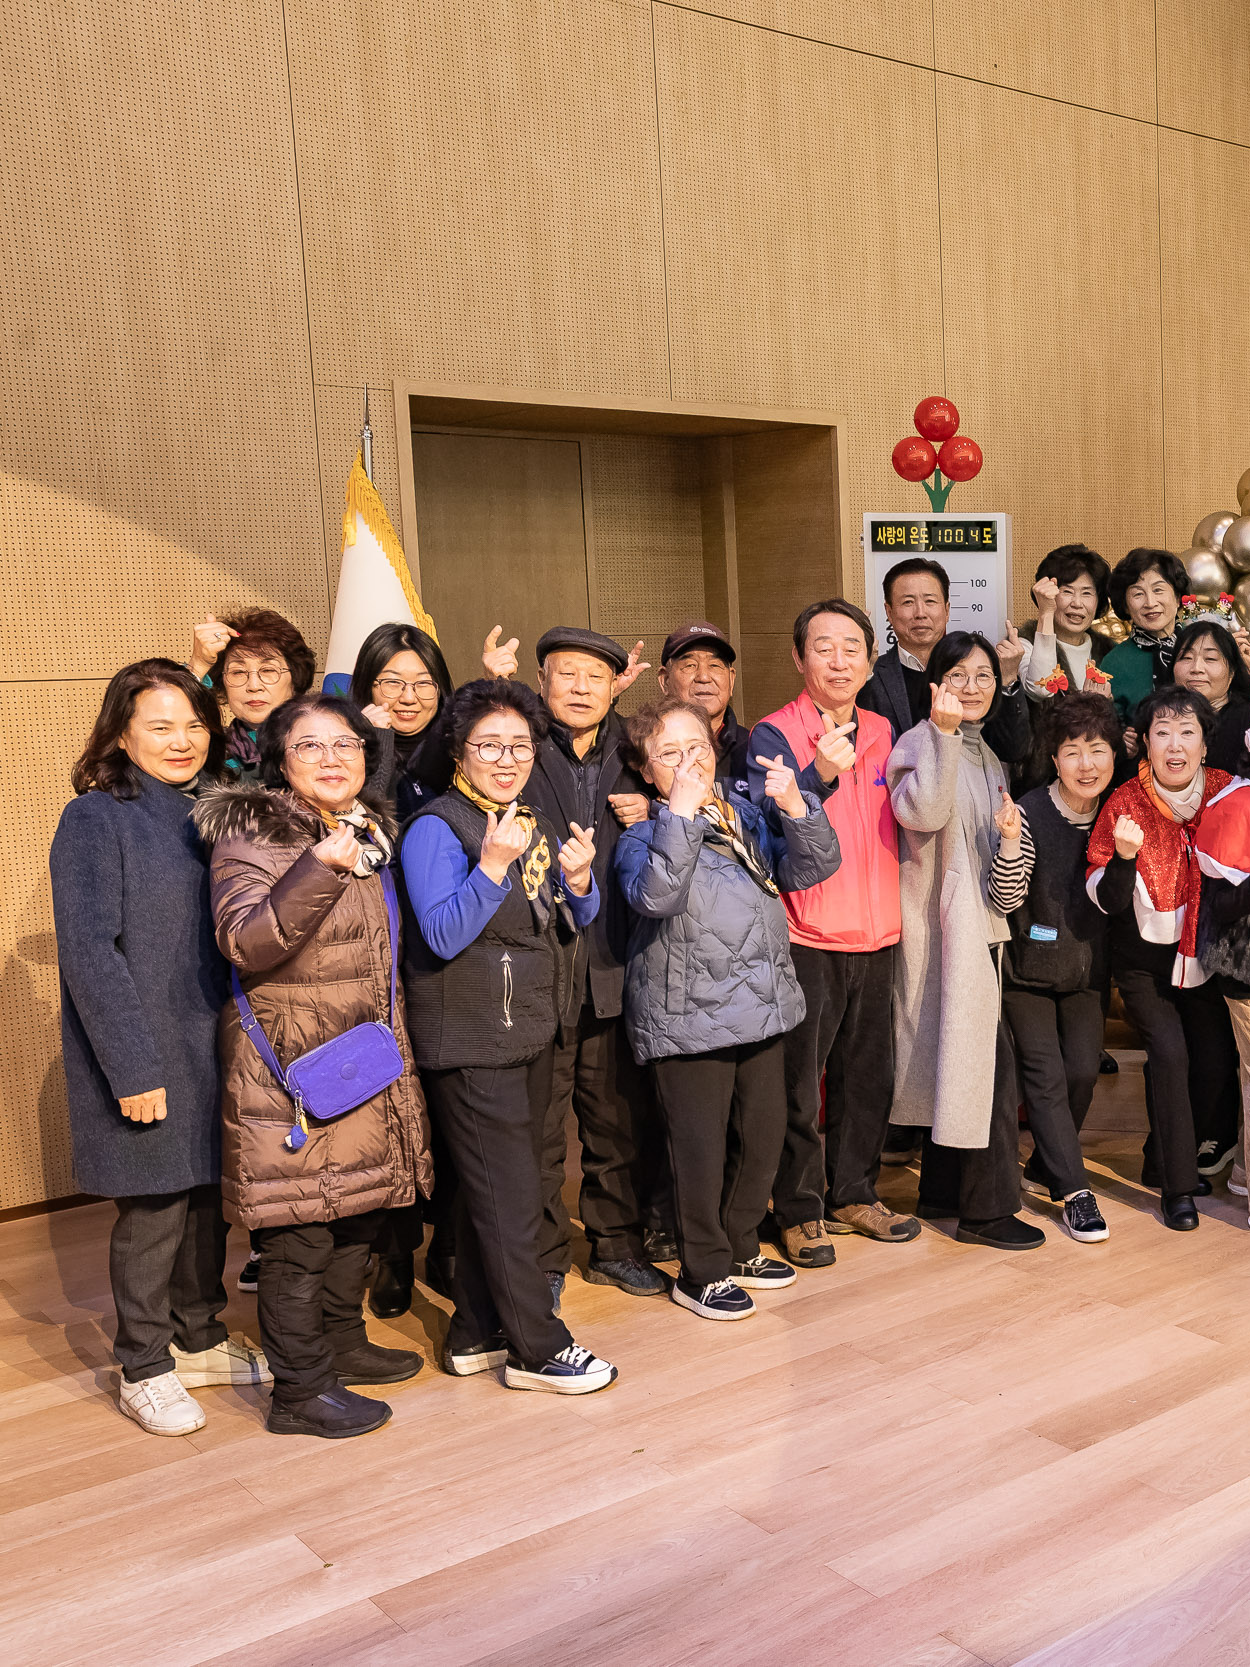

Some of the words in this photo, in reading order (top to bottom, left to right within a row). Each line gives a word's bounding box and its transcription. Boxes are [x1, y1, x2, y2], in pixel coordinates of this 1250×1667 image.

[876, 526, 906, 545] 사랑의
[909, 526, 929, 545] 온도
[937, 528, 979, 545] 100.4
[982, 527, 993, 544] 도
[970, 579, 987, 588] 100
[971, 603, 983, 612] 90
